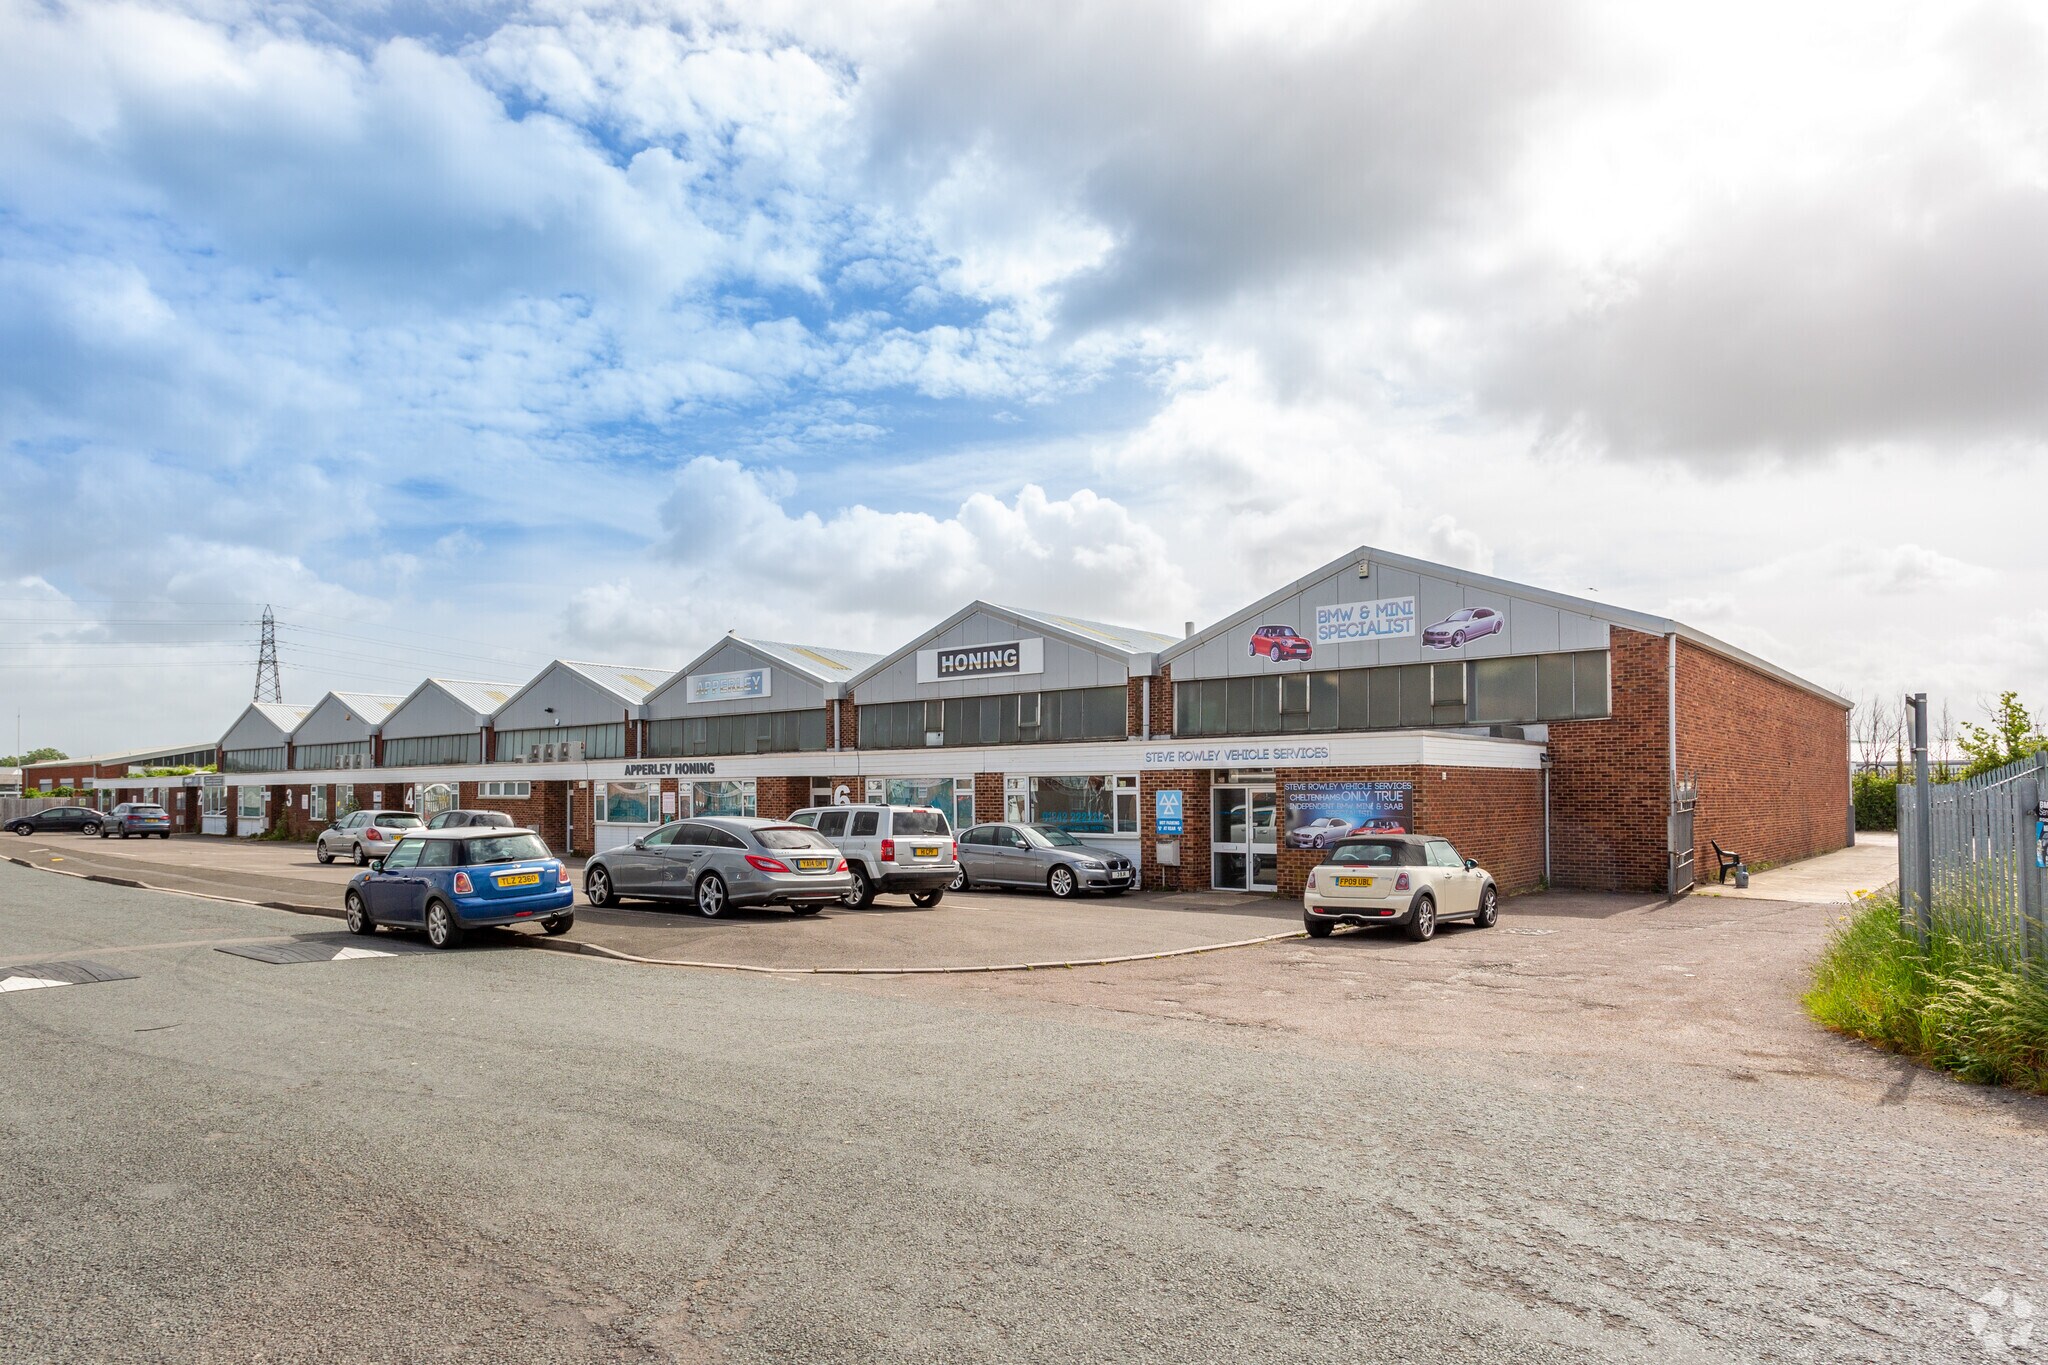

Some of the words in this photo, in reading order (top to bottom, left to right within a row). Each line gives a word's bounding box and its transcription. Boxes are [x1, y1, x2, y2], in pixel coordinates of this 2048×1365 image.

[1317, 606, 1354, 624] BMW
[1359, 604, 1371, 618] &
[1375, 600, 1414, 618] MINI
[1317, 616, 1414, 640] SPECIALIST
[941, 648, 1018, 673] HONING
[696, 675, 761, 696] APPERLEY
[1145, 751, 1175, 763] STEVE
[1178, 750, 1221, 762] ROWLEY
[1224, 748, 1270, 761] VEHICLE
[1273, 747, 1329, 760] SERVICES
[624, 763, 672, 776] APPERLEY
[674, 762, 715, 775] HONING
[1284, 783, 1306, 791] STEVE
[1308, 782, 1339, 791] ROWLEY
[1340, 782, 1372, 790] VEHICLE
[1374, 781, 1412, 790] SERVICES
[197, 790, 203, 806] 2
[286, 788, 292, 806] 3
[405, 787, 414, 808] 4
[834, 785, 850, 805] 6
[1289, 793, 1341, 801] CHELTENHAMS
[1341, 790, 1371, 802] ONLY
[1374, 790, 1403, 802] TRUE
[1289, 802, 1335, 810] INDEPENDENT
[1384, 802, 1404, 810] SAAB
[501, 876, 517, 885] TLZ
[517, 874, 536, 884] 2360
